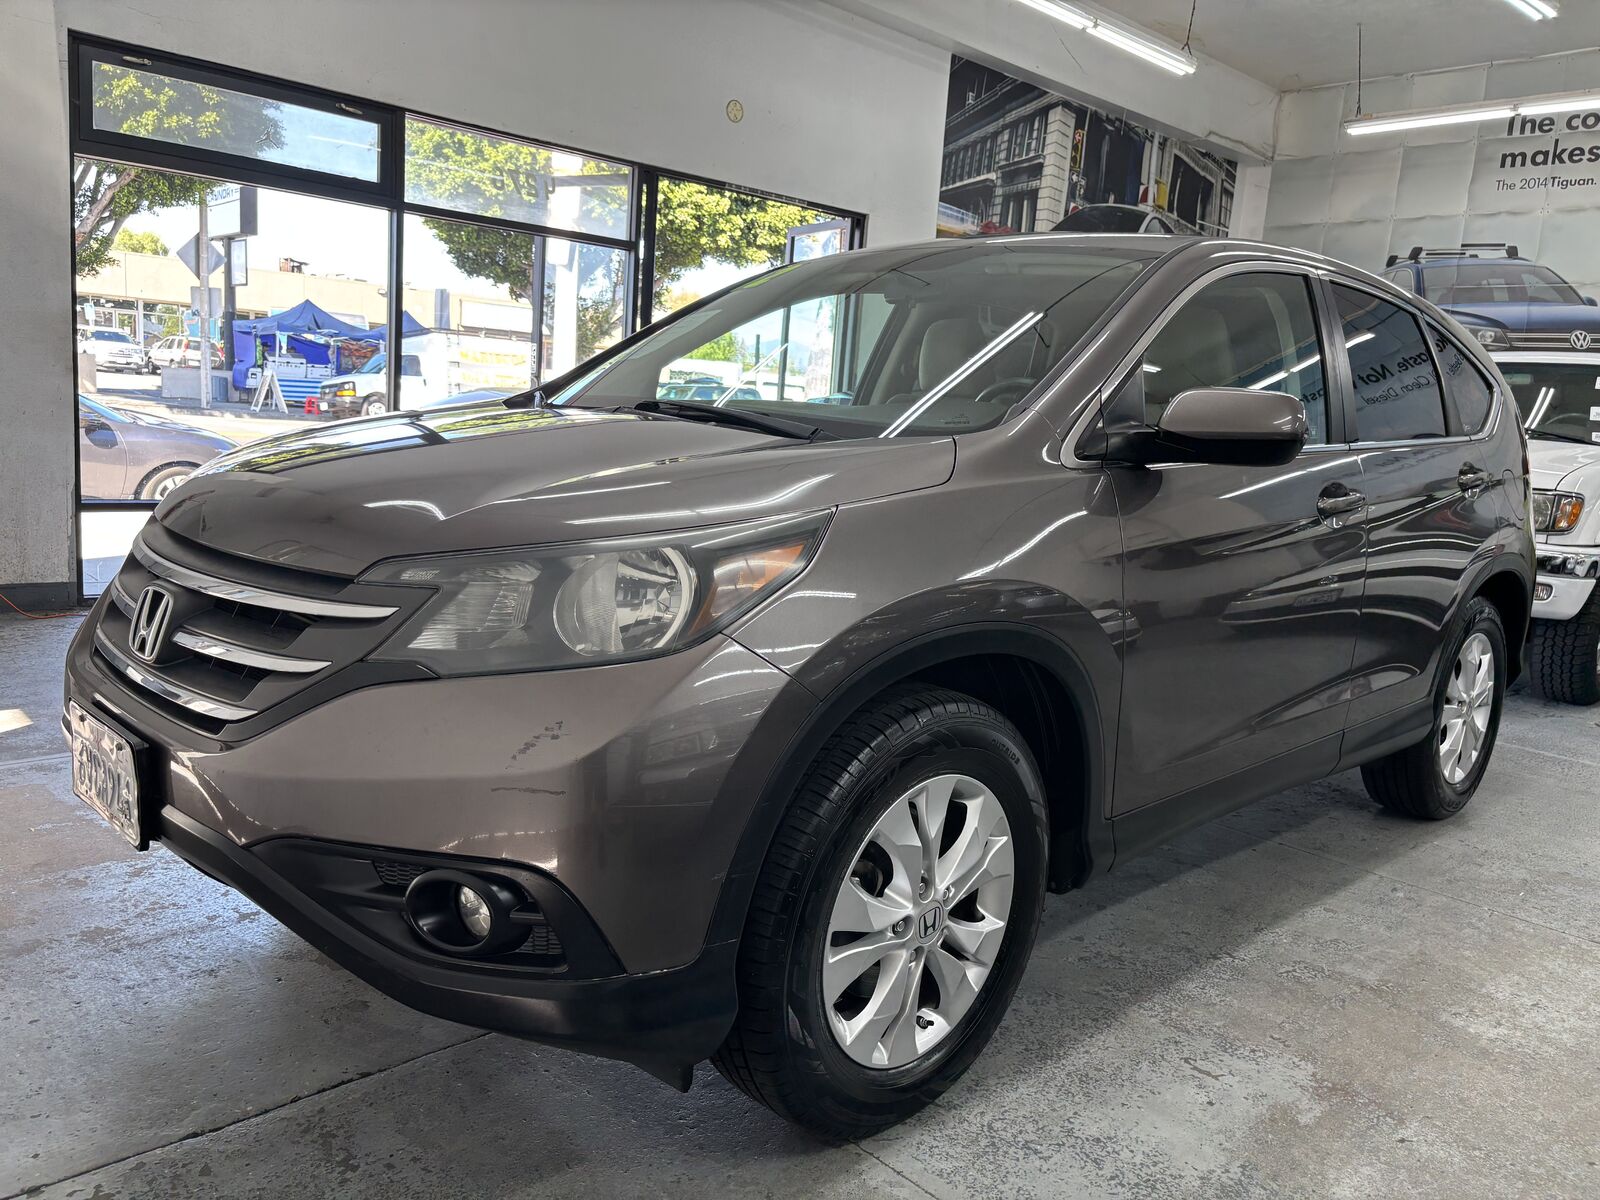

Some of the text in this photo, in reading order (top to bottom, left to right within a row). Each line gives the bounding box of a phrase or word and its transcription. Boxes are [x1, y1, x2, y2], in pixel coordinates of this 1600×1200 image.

[1507, 113, 1555, 136] The
[1500, 138, 1600, 168] makes
[1496, 176, 1597, 191] The 2014 Tiguan.
